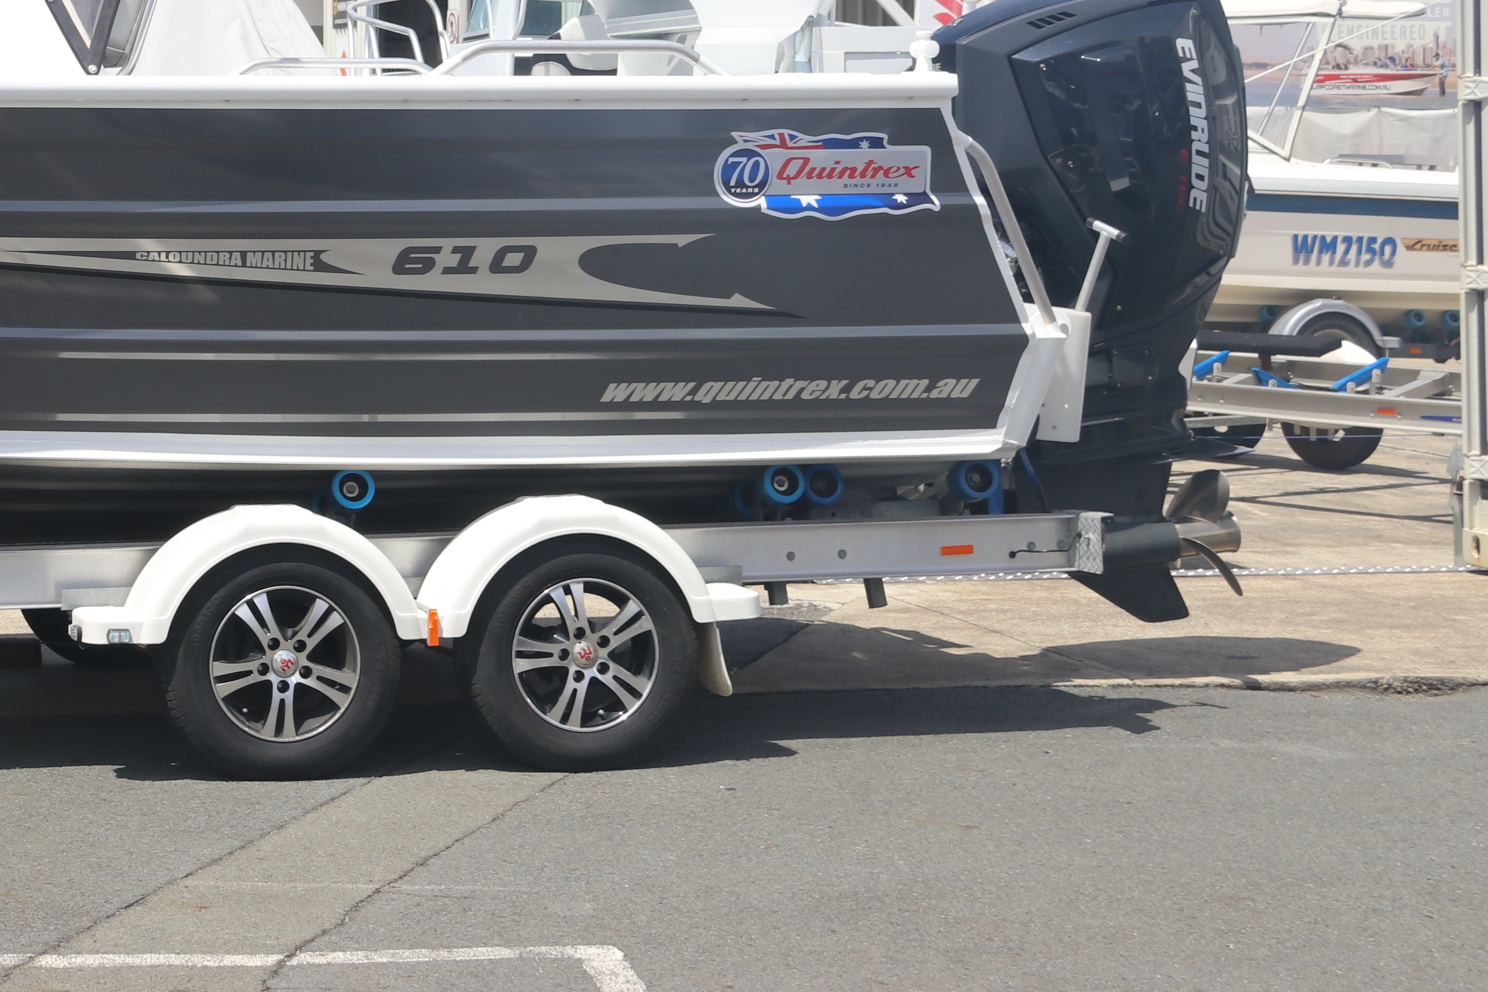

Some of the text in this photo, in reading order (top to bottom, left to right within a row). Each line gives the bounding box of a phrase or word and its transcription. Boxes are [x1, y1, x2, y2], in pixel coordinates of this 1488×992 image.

[1337, 24, 1426, 41] ENGINEERED
[1175, 37, 1210, 213] EVINRUDE
[727, 156, 765, 187] 70
[776, 156, 920, 185] Quintrex
[135, 251, 314, 270] CALOUNDRA MARINE
[392, 244, 538, 275] 610
[1291, 234, 1398, 269] WM215Q
[600, 377, 980, 403] www.quintrex.com.au
